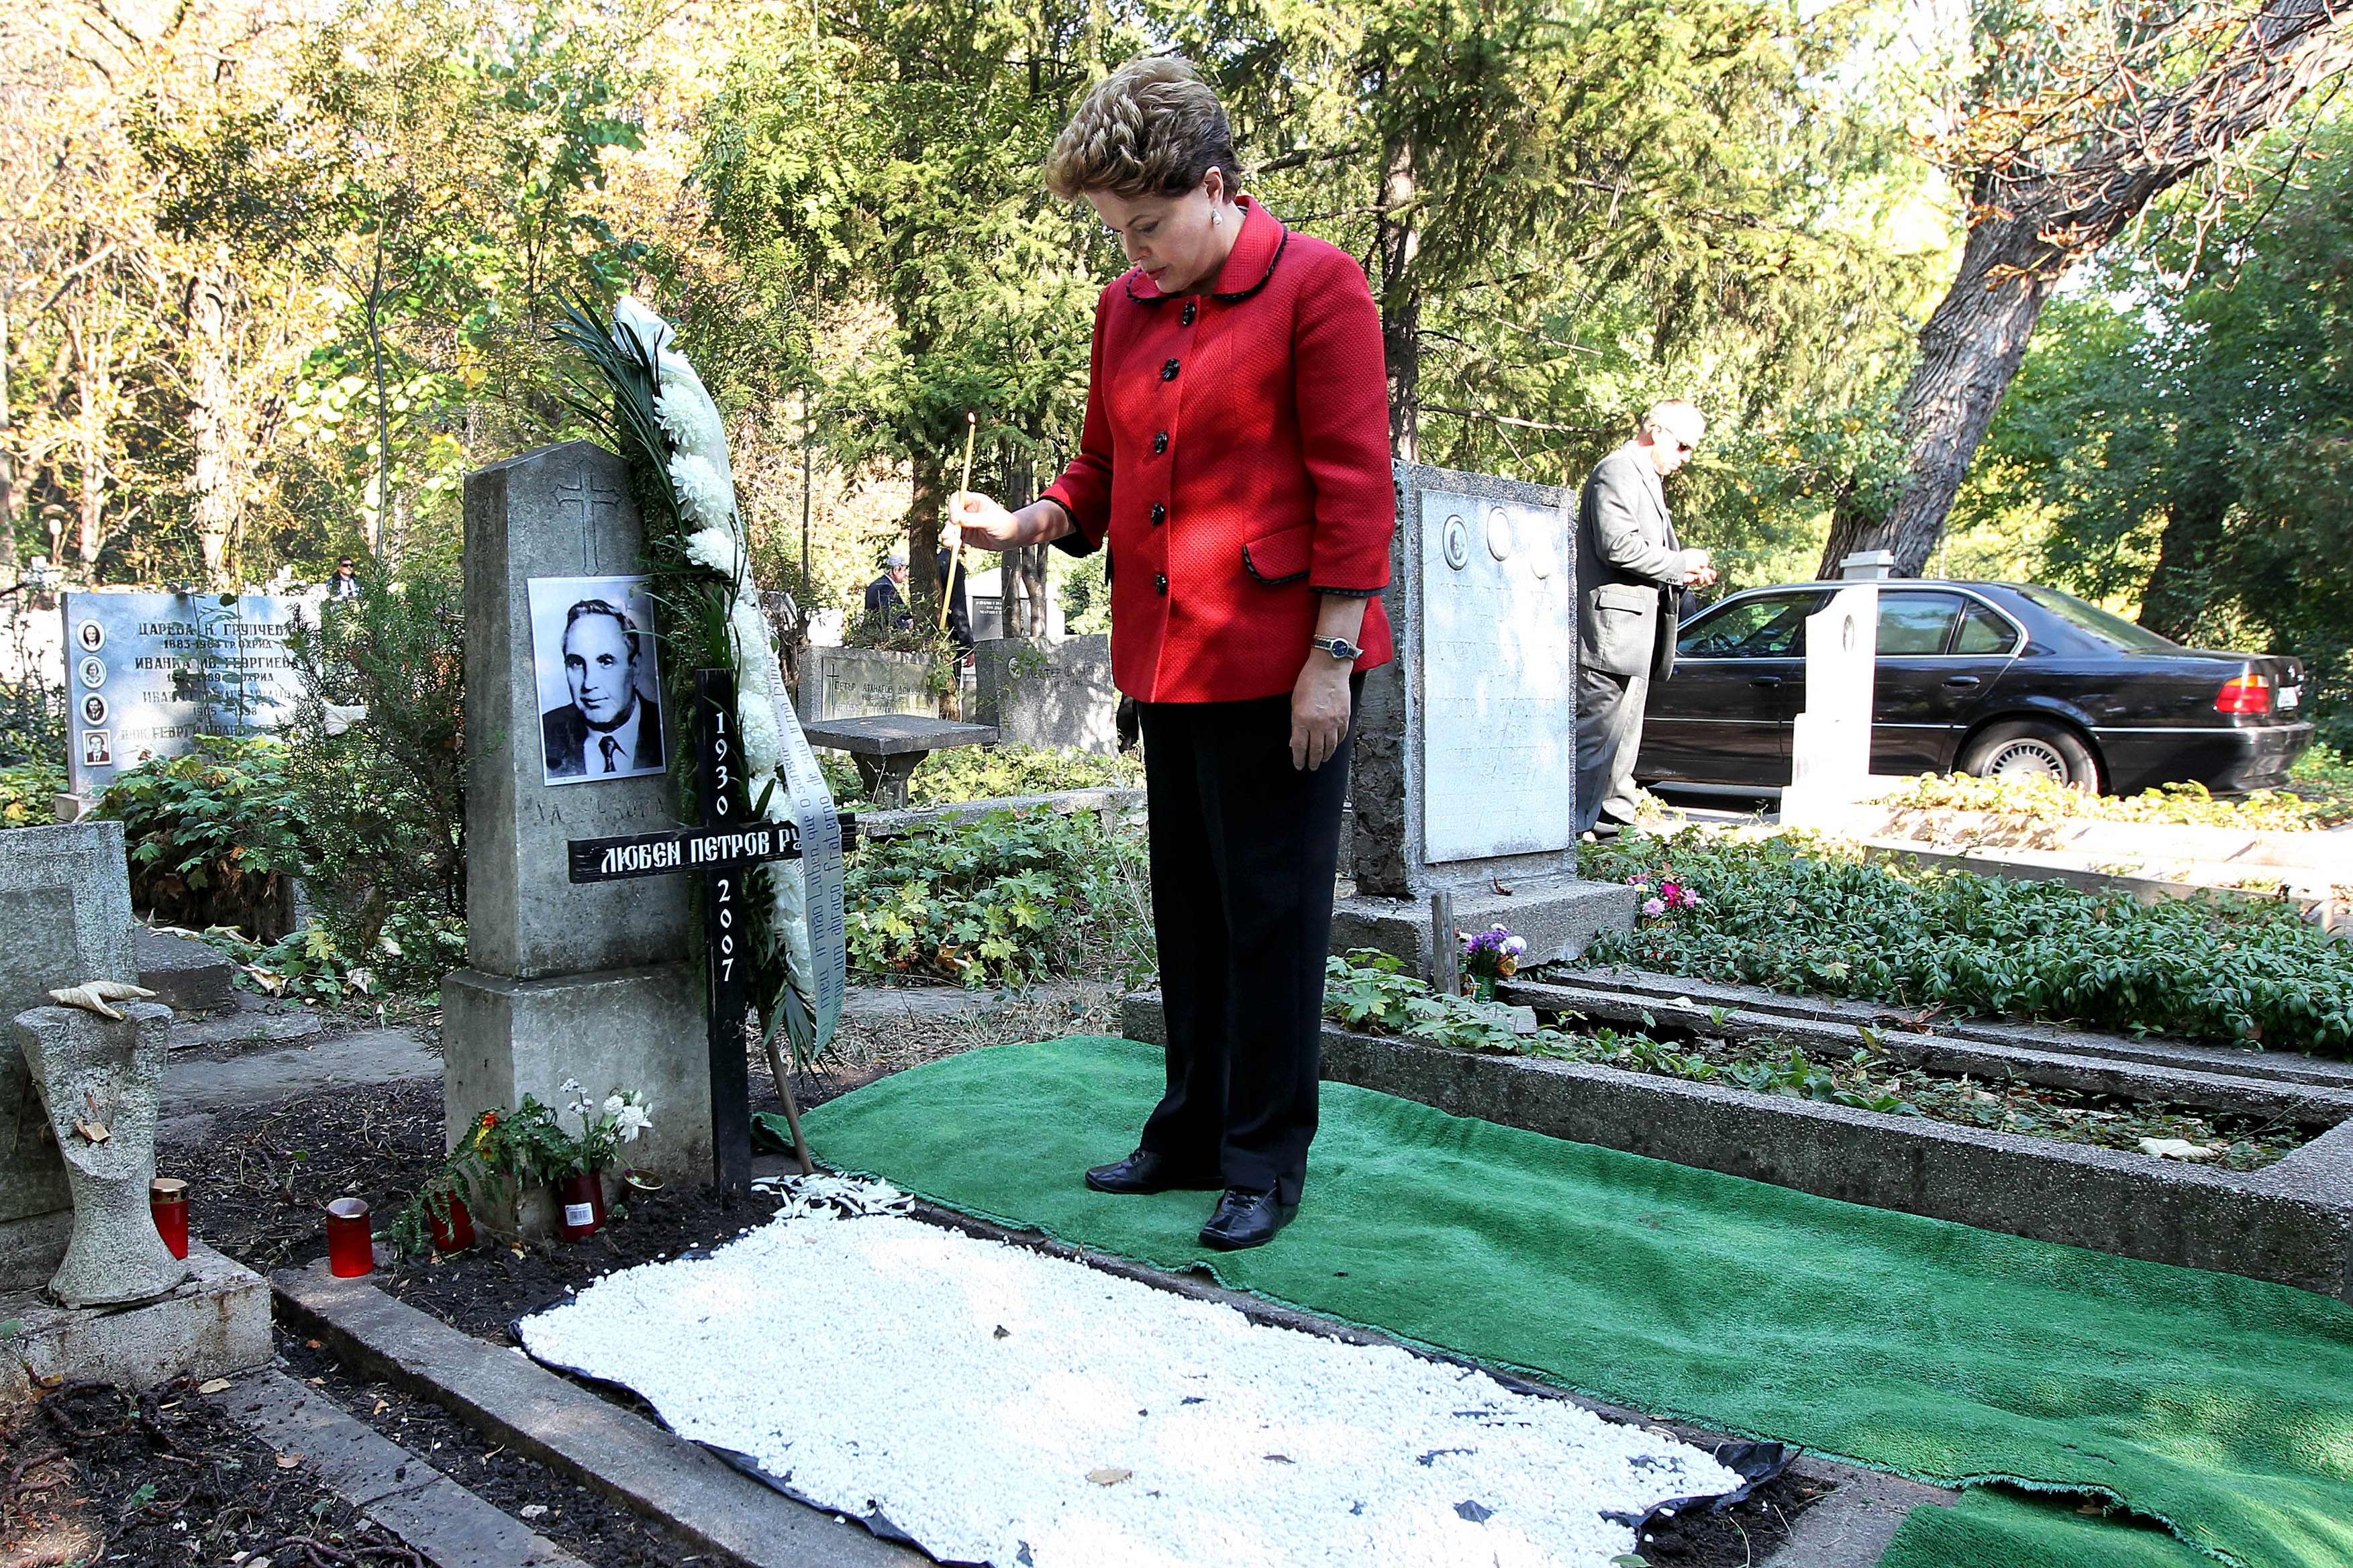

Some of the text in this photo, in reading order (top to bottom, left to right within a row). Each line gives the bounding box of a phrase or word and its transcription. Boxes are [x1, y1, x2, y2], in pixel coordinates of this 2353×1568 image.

[768, 656, 785, 697] Dilma
[835, 681, 856, 691] ПЕТЪР
[715, 712, 728, 815] 1930
[781, 747, 806, 794] sangue
[794, 739, 813, 765] sua
[807, 771, 823, 786] de
[799, 798, 811, 808] o
[804, 815, 819, 841] que
[819, 796, 841, 873] fraterno
[601, 841, 681, 874] ЛЮБЕН
[691, 829, 770, 864] ПЕТРОВ
[717, 879, 734, 982] 2007
[812, 904, 827, 957] irmão
[827, 883, 842, 937] abraço
[832, 944, 844, 972] um
[819, 966, 831, 1010] meu
